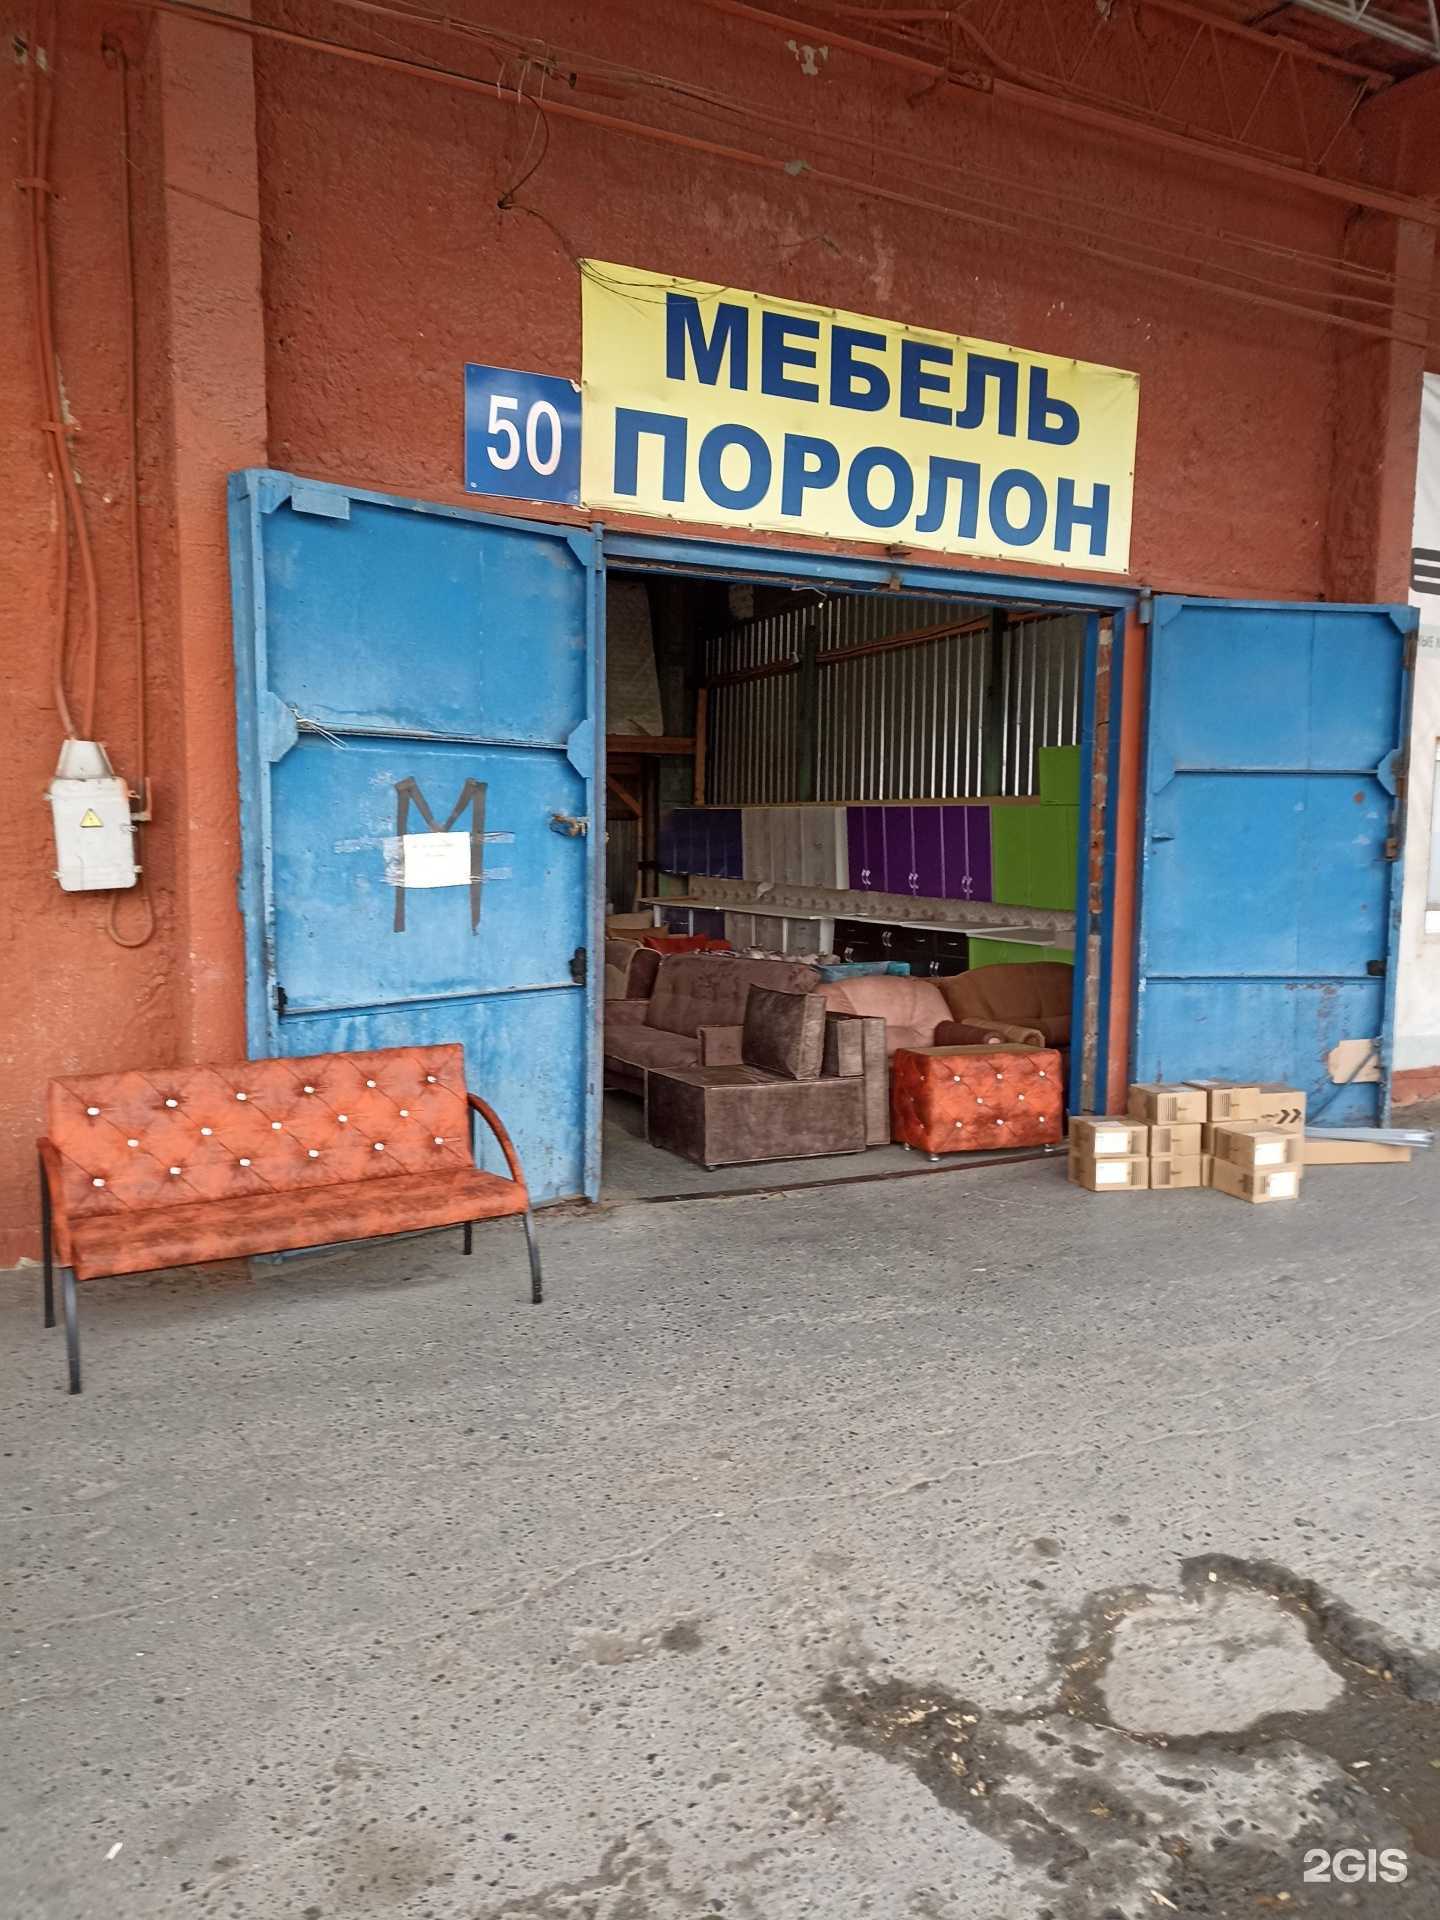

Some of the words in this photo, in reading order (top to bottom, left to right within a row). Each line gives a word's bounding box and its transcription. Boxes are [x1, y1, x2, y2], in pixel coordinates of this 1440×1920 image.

[486, 394, 562, 477] 50
[665, 292, 1081, 446] МЕБЕЛЬ
[613, 406, 1111, 557] ПОРОЛОН
